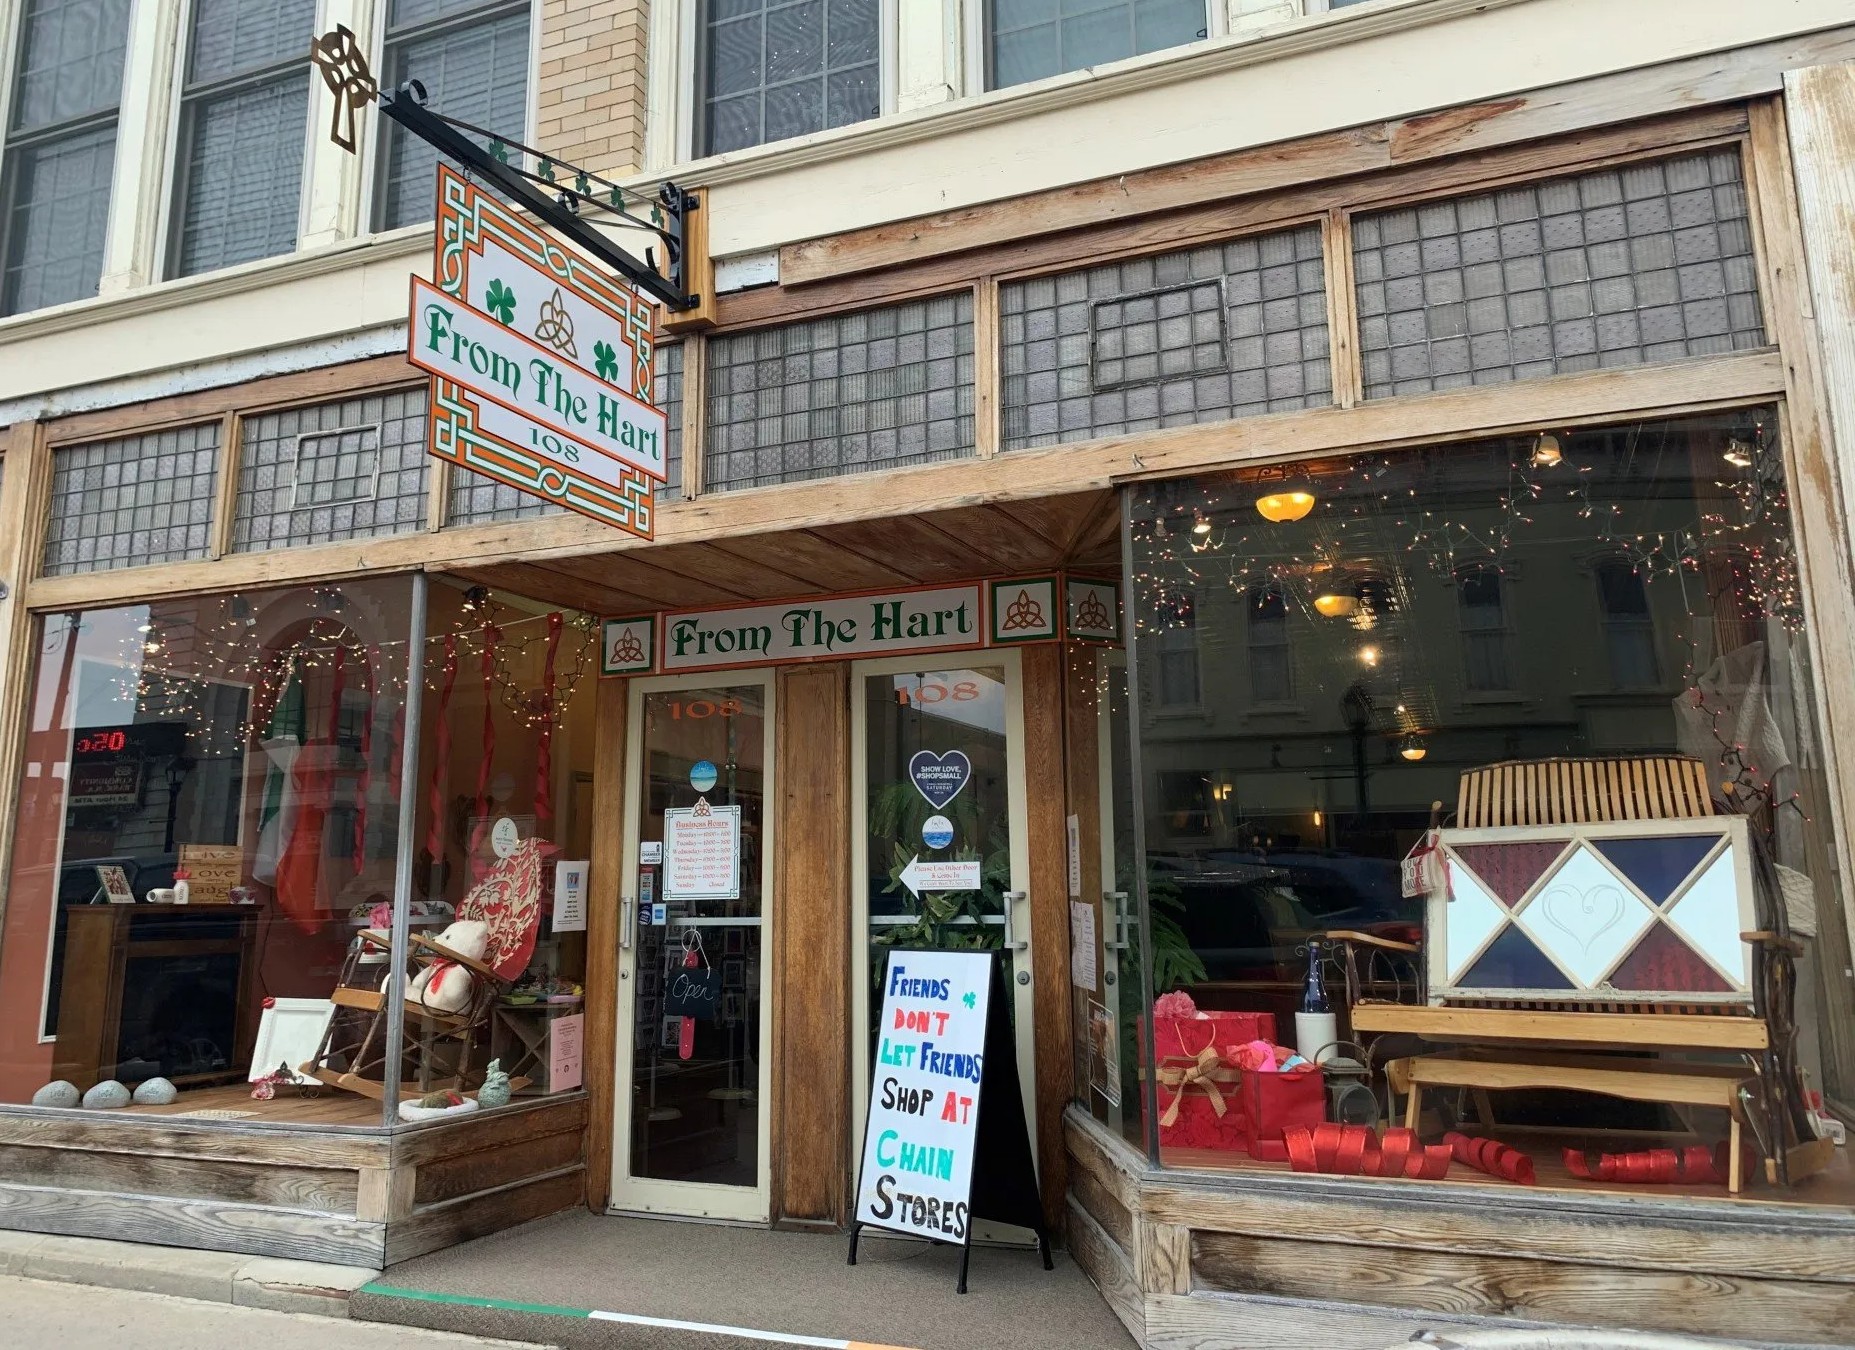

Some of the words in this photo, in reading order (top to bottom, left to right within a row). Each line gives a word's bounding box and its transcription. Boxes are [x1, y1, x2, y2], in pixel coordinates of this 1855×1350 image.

[424, 303, 521, 400] From
[529, 359, 588, 426] The
[596, 392, 661, 462] Hart
[529, 427, 580, 463] 108
[671, 617, 772, 657] From
[782, 607, 857, 651] The
[870, 600, 973, 641] Hart
[669, 696, 744, 720] 108
[897, 681, 980, 706] 108
[672, 973, 714, 1005] Open
[890, 966, 950, 1000] FRIENDS
[894, 1008, 950, 1036] DON'T
[881, 1038, 917, 1067] LET
[920, 1042, 983, 1084] FRIENDS
[881, 1077, 934, 1117] SHOP
[941, 1091, 973, 1125] AT
[876, 1129, 954, 1182] CHAIN
[870, 1174, 969, 1239] STORES
